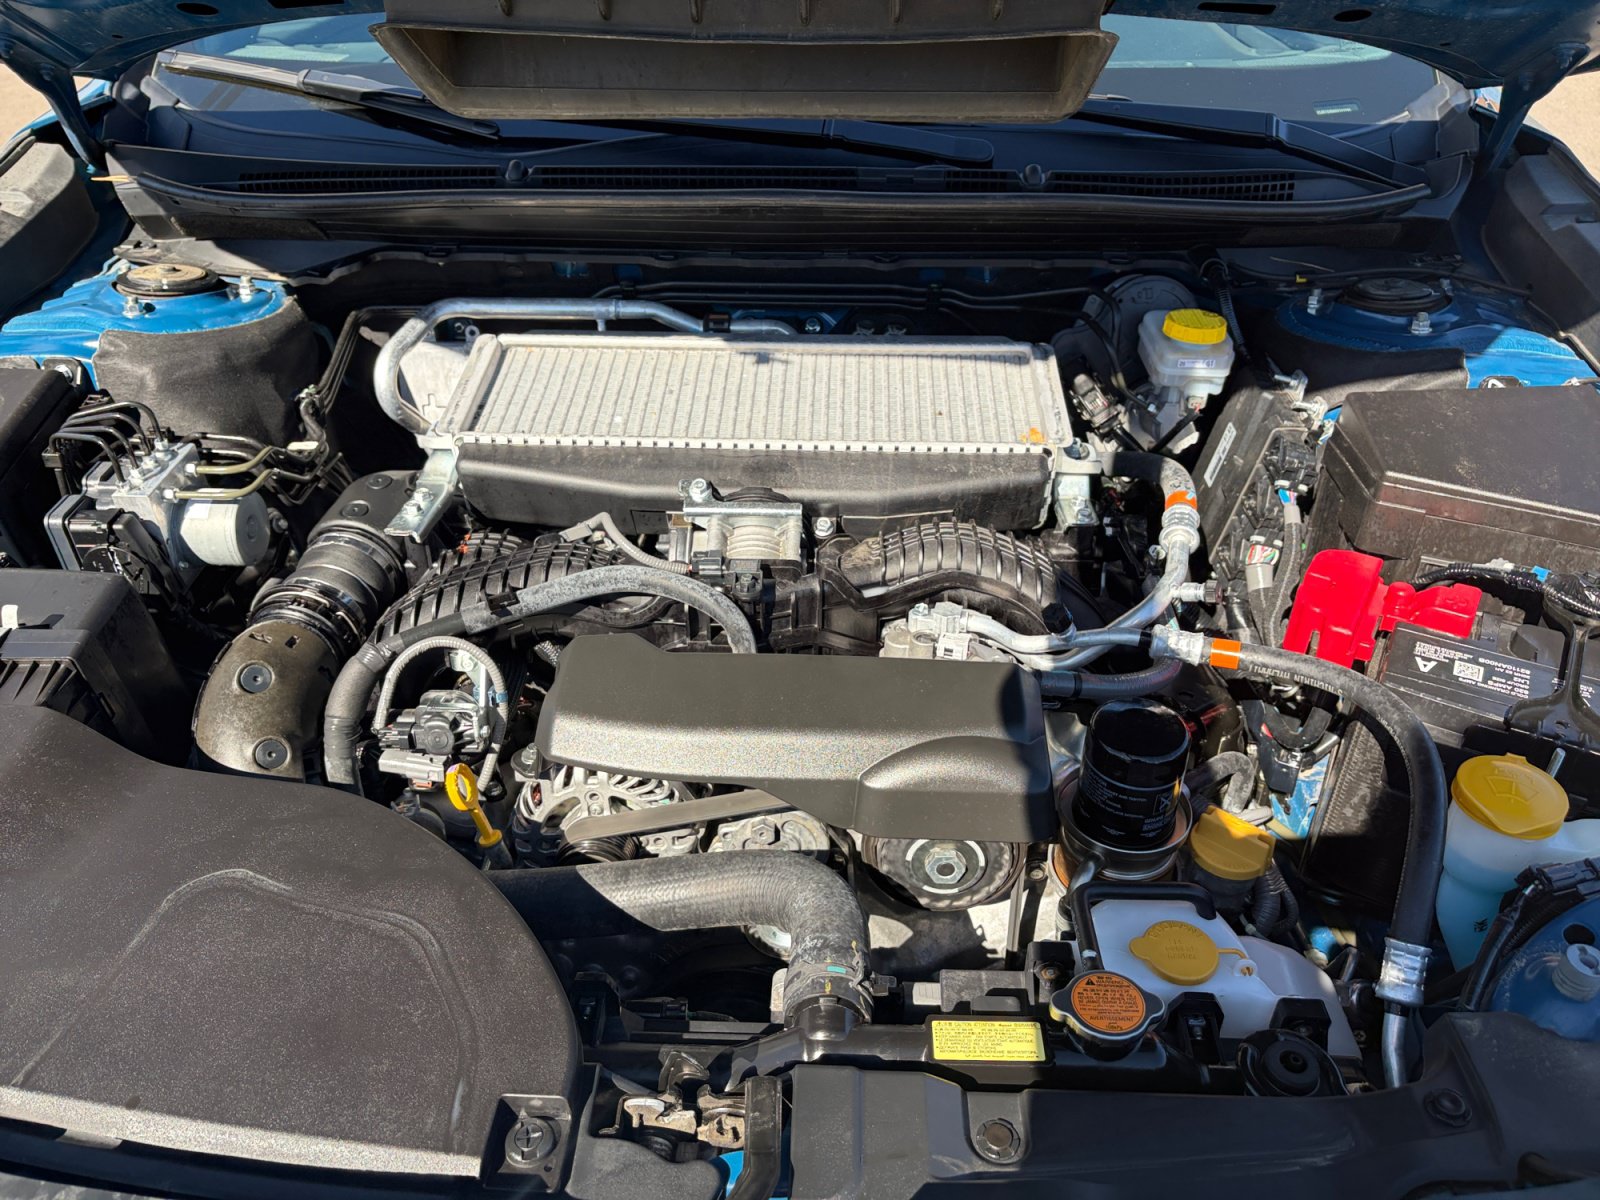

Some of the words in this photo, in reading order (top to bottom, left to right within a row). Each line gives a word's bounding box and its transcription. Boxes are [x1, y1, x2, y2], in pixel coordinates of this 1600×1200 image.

[1513, 676, 1530, 684] LN2
[1477, 682, 1510, 695] CRANKING
[1487, 680, 1513, 690] AMPS
[1510, 690, 1529, 699] COLD
